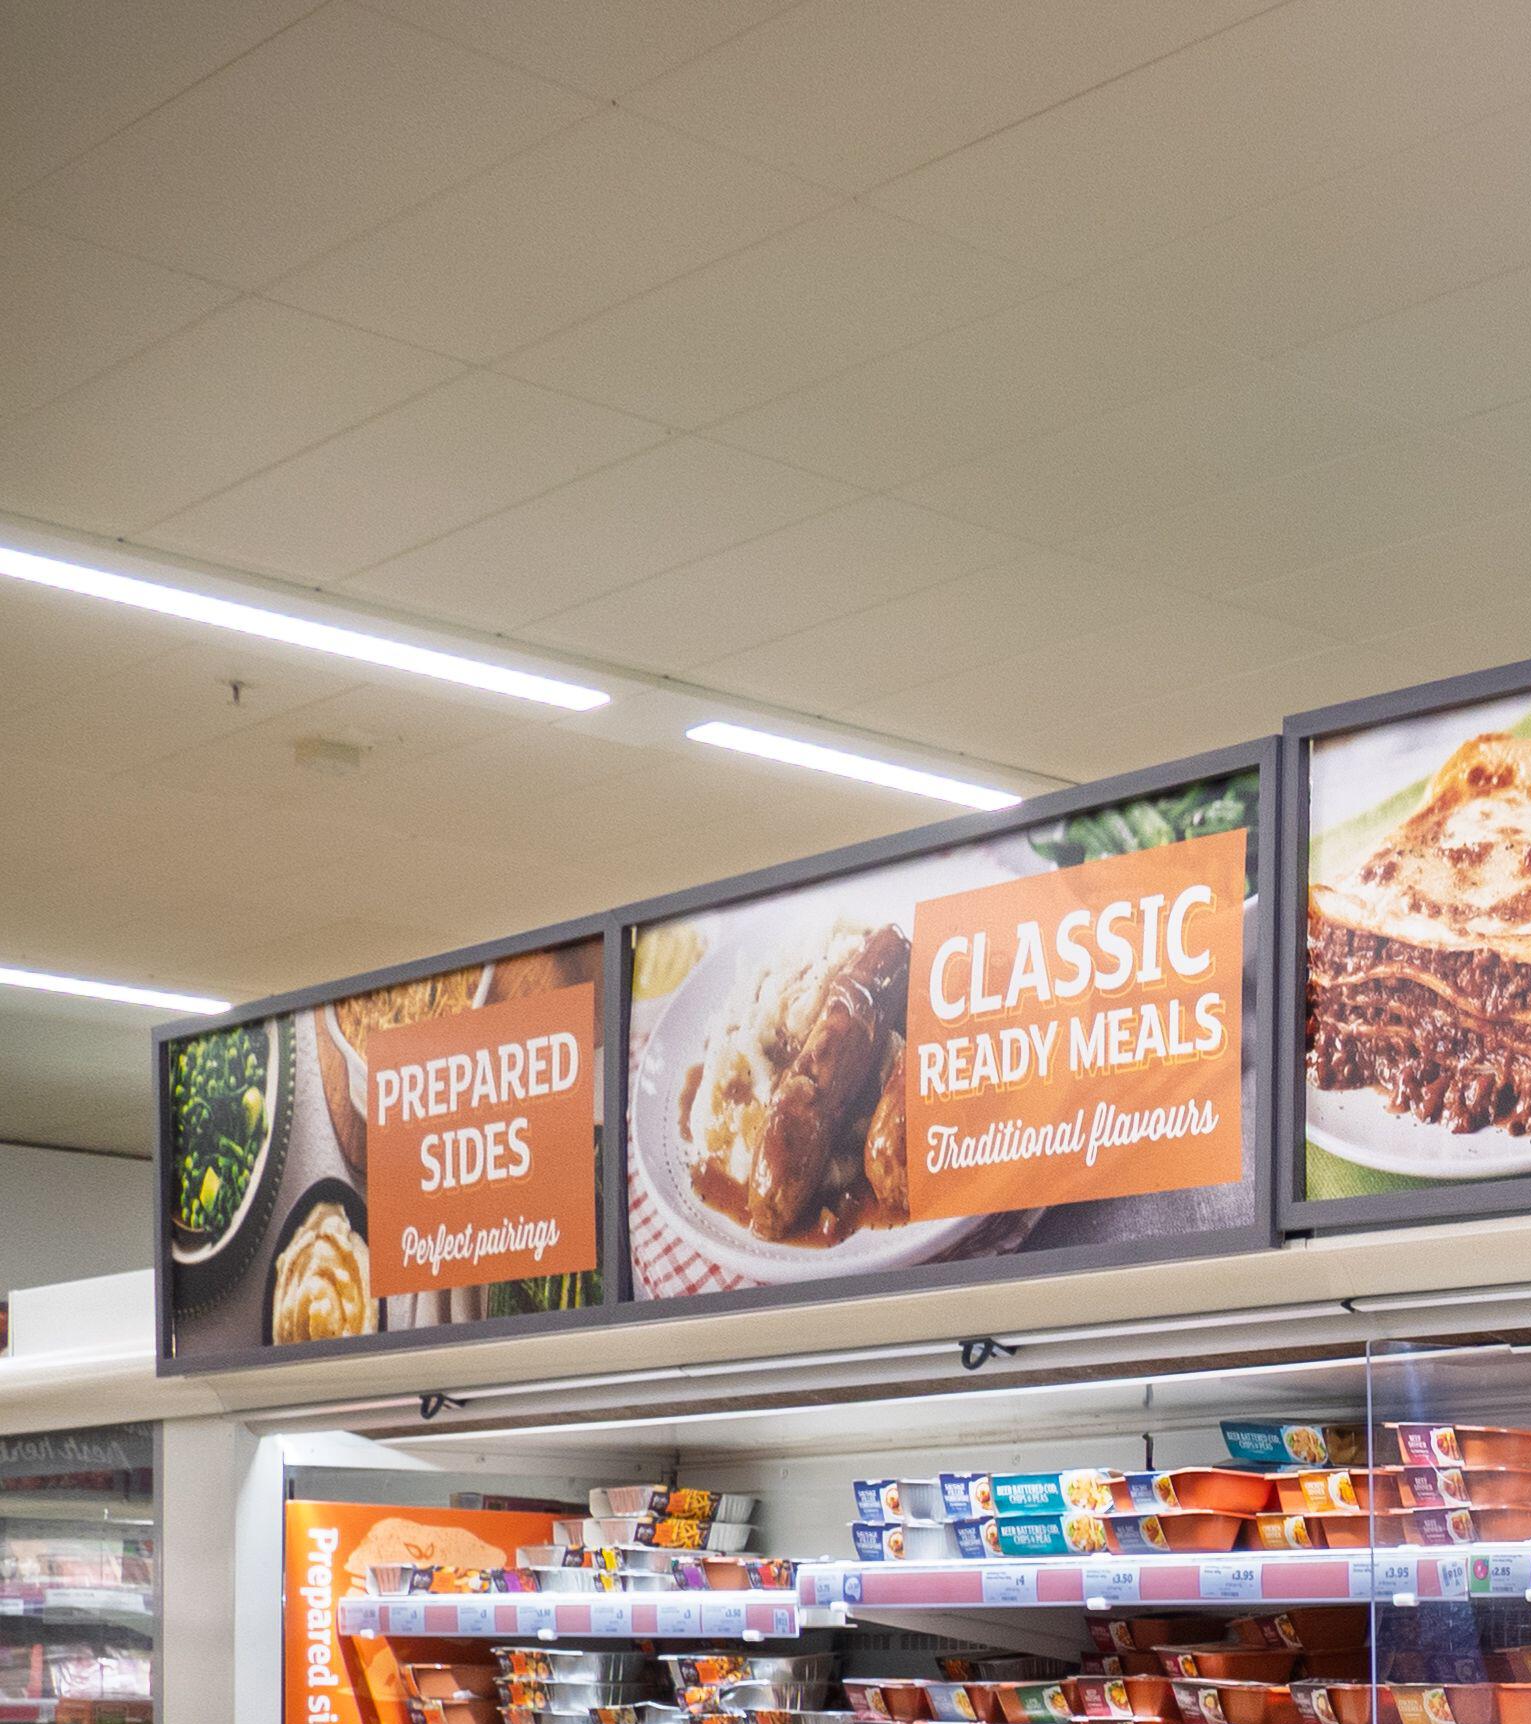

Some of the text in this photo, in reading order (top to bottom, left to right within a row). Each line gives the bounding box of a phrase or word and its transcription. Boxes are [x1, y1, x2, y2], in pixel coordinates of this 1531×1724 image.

[930, 885, 1211, 1019] CLASSIC
[376, 1032, 578, 1125] PREPARED
[918, 993, 1223, 1097] READY MEALS
[420, 1117, 530, 1192] SIDES
[927, 1099, 1218, 1173] Traditional flavours
[402, 1216, 559, 1276] Perfect pairings
[299, 1526, 339, 1689] Prepared
[1232, 1570, 1254, 1581] £3.95
[1491, 1566, 1512, 1577] £2.85
